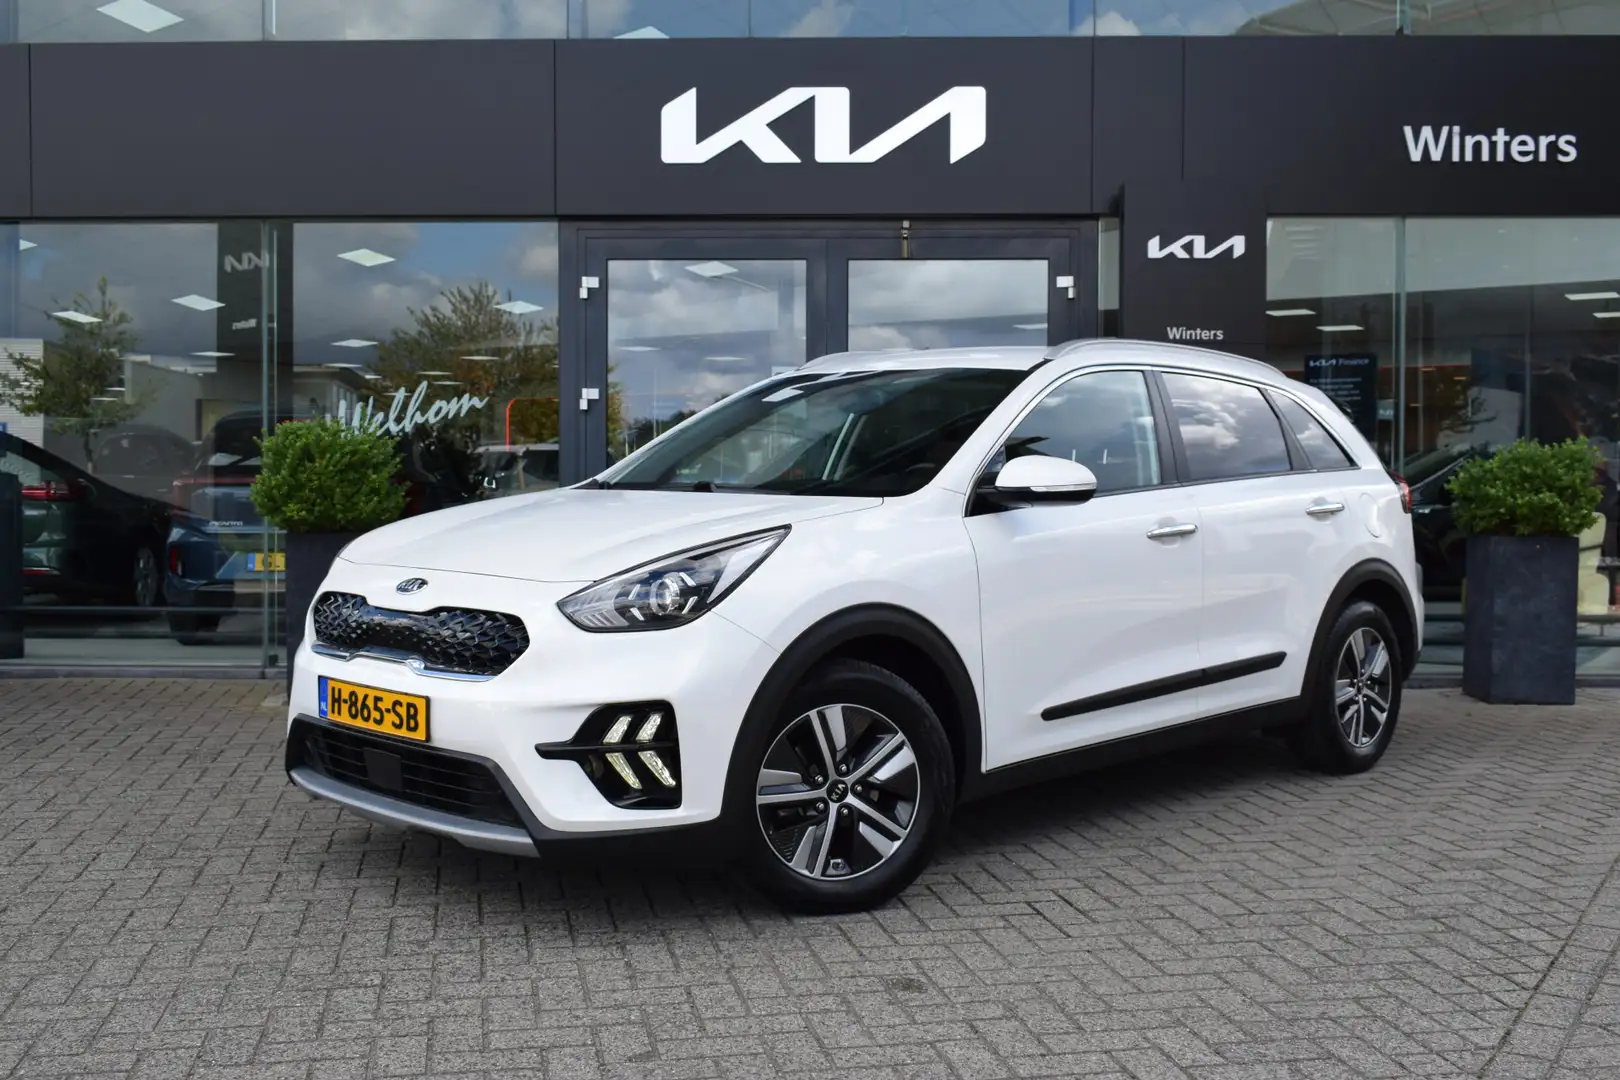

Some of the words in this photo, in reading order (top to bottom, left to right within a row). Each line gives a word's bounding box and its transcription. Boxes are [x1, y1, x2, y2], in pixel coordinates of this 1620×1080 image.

[661, 86, 987, 164] KIA
[1403, 125, 1578, 163] Winters
[1147, 235, 1246, 259] KIA
[1167, 326, 1224, 340] Winters
[331, 686, 419, 733] H-865-SB
[831, 783, 846, 801] KIA
